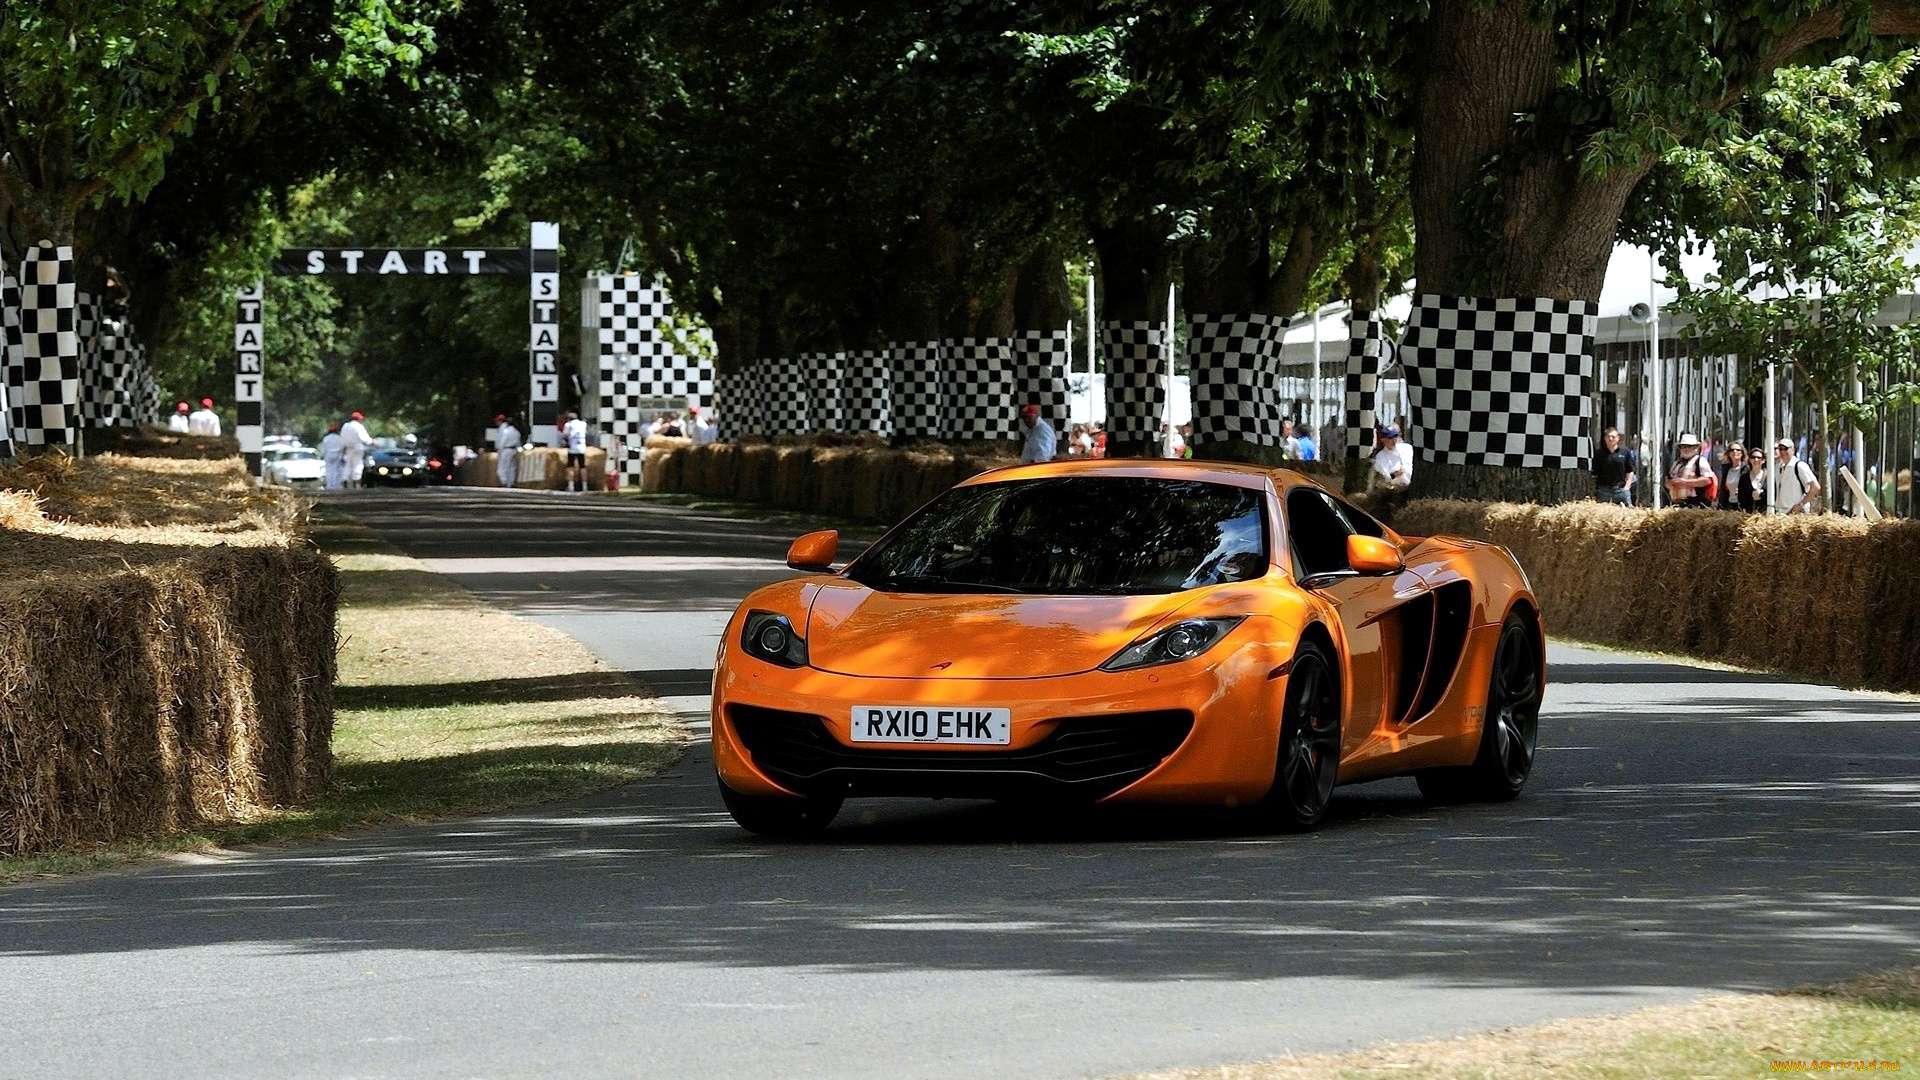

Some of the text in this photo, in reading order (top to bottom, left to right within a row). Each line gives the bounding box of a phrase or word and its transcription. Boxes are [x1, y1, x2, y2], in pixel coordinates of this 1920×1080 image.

[307, 250, 486, 275] START
[536, 279, 556, 396] START
[867, 709, 992, 739] RX10 EHK
